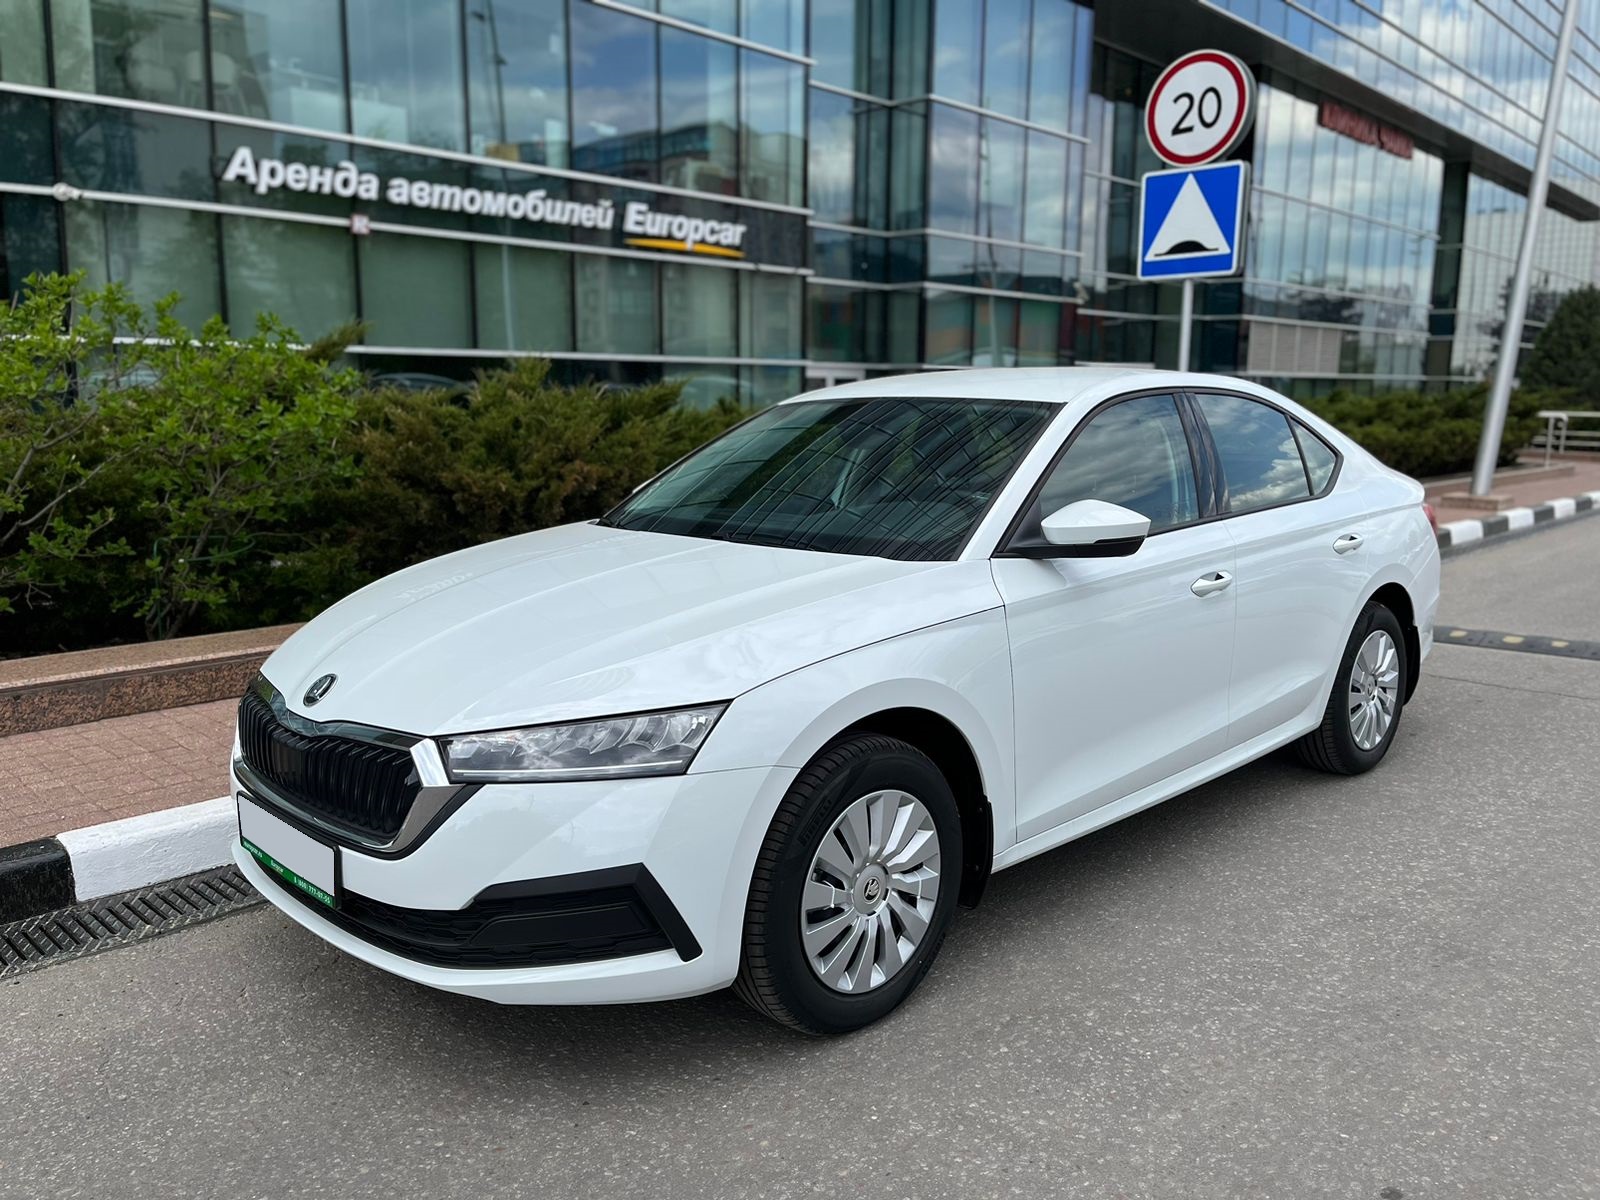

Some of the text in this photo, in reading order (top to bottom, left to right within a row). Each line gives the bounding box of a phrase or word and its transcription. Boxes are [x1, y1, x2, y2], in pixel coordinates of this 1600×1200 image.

[1171, 86, 1222, 136] 20
[222, 146, 748, 251] Аренда автомобилей Europcar
